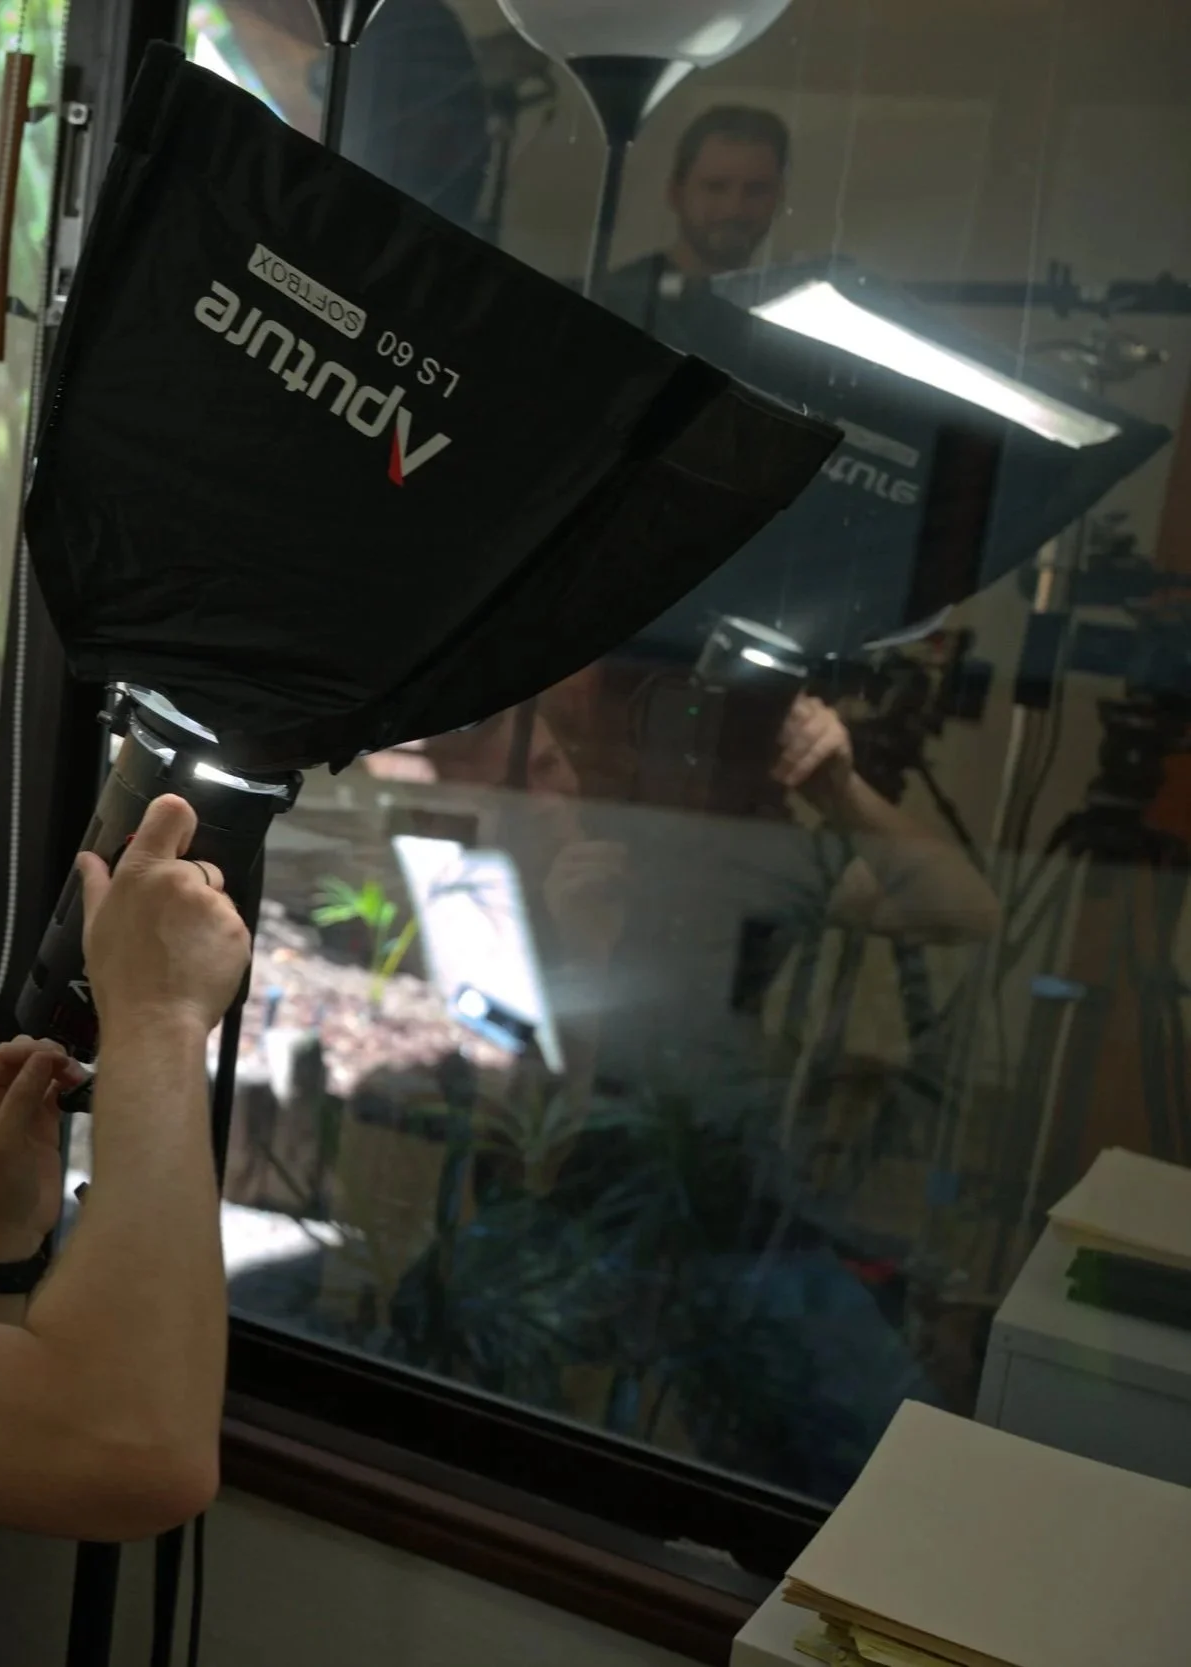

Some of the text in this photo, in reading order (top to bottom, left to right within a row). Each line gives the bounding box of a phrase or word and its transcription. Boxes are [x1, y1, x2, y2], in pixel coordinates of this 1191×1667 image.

[194, 280, 452, 486] Aputure
[252, 249, 460, 398] LS 60 SOFTBOX
